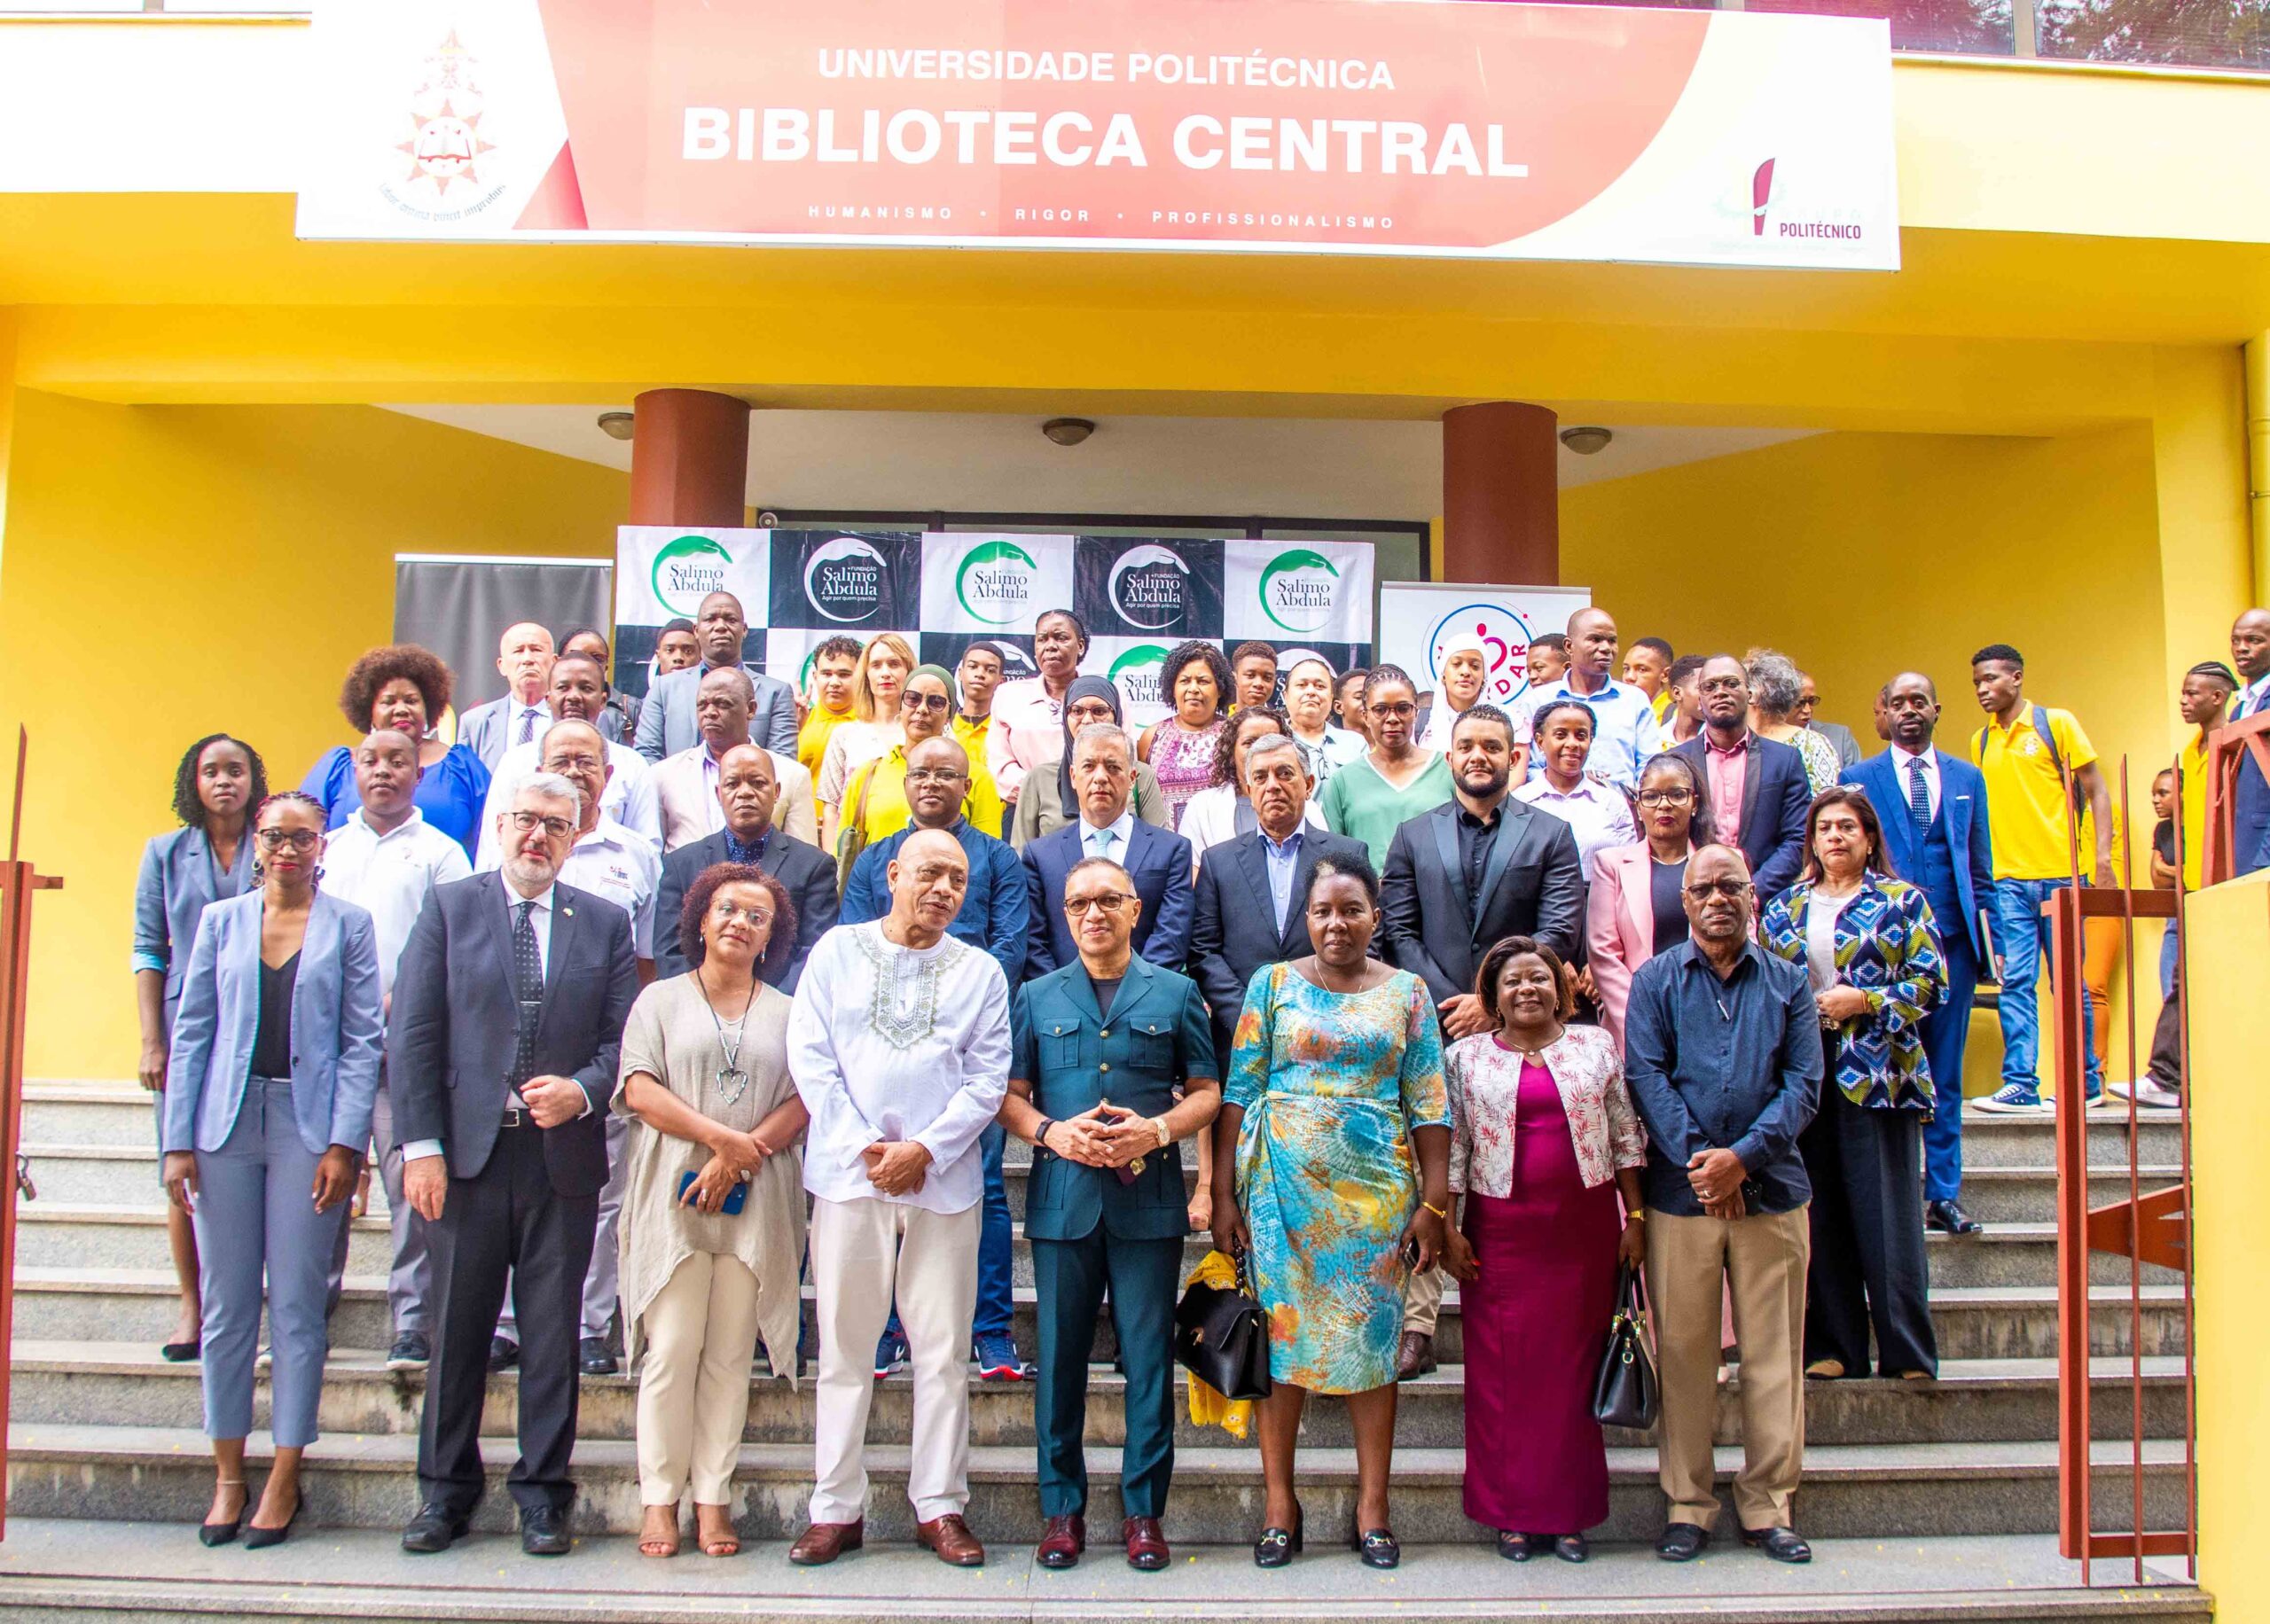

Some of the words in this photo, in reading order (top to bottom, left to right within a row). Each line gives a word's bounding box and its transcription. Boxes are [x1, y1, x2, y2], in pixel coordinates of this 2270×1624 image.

[818, 48, 1115, 82] UNIVERSIDADE
[1128, 49, 1396, 90] POLITÉCNICA
[682, 106, 1147, 168] BIBLIOTECA
[1172, 113, 1529, 178] CENTRAL
[808, 205, 952, 220] HUMANISMO
[1014, 208, 1090, 223] RIGOR
[1152, 210, 1393, 230] PROFISSIONALISMO
[1780, 220, 1861, 239] POLITÉCNICO
[669, 564, 724, 579] Salimo
[823, 566, 877, 582] Salimo
[975, 570, 1028, 585] Salimo
[668, 578, 724, 592] Abdula
[821, 581, 878, 596] Abdula
[1127, 574, 1180, 589] Salimo
[1277, 579, 1330, 593] Salimo
[973, 584, 1028, 598] Abdula
[1124, 588, 1181, 603] Abdula
[1276, 592, 1331, 606] Abdula
[1124, 674, 1161, 689] Sali
[1126, 688, 1163, 702] Abdu
